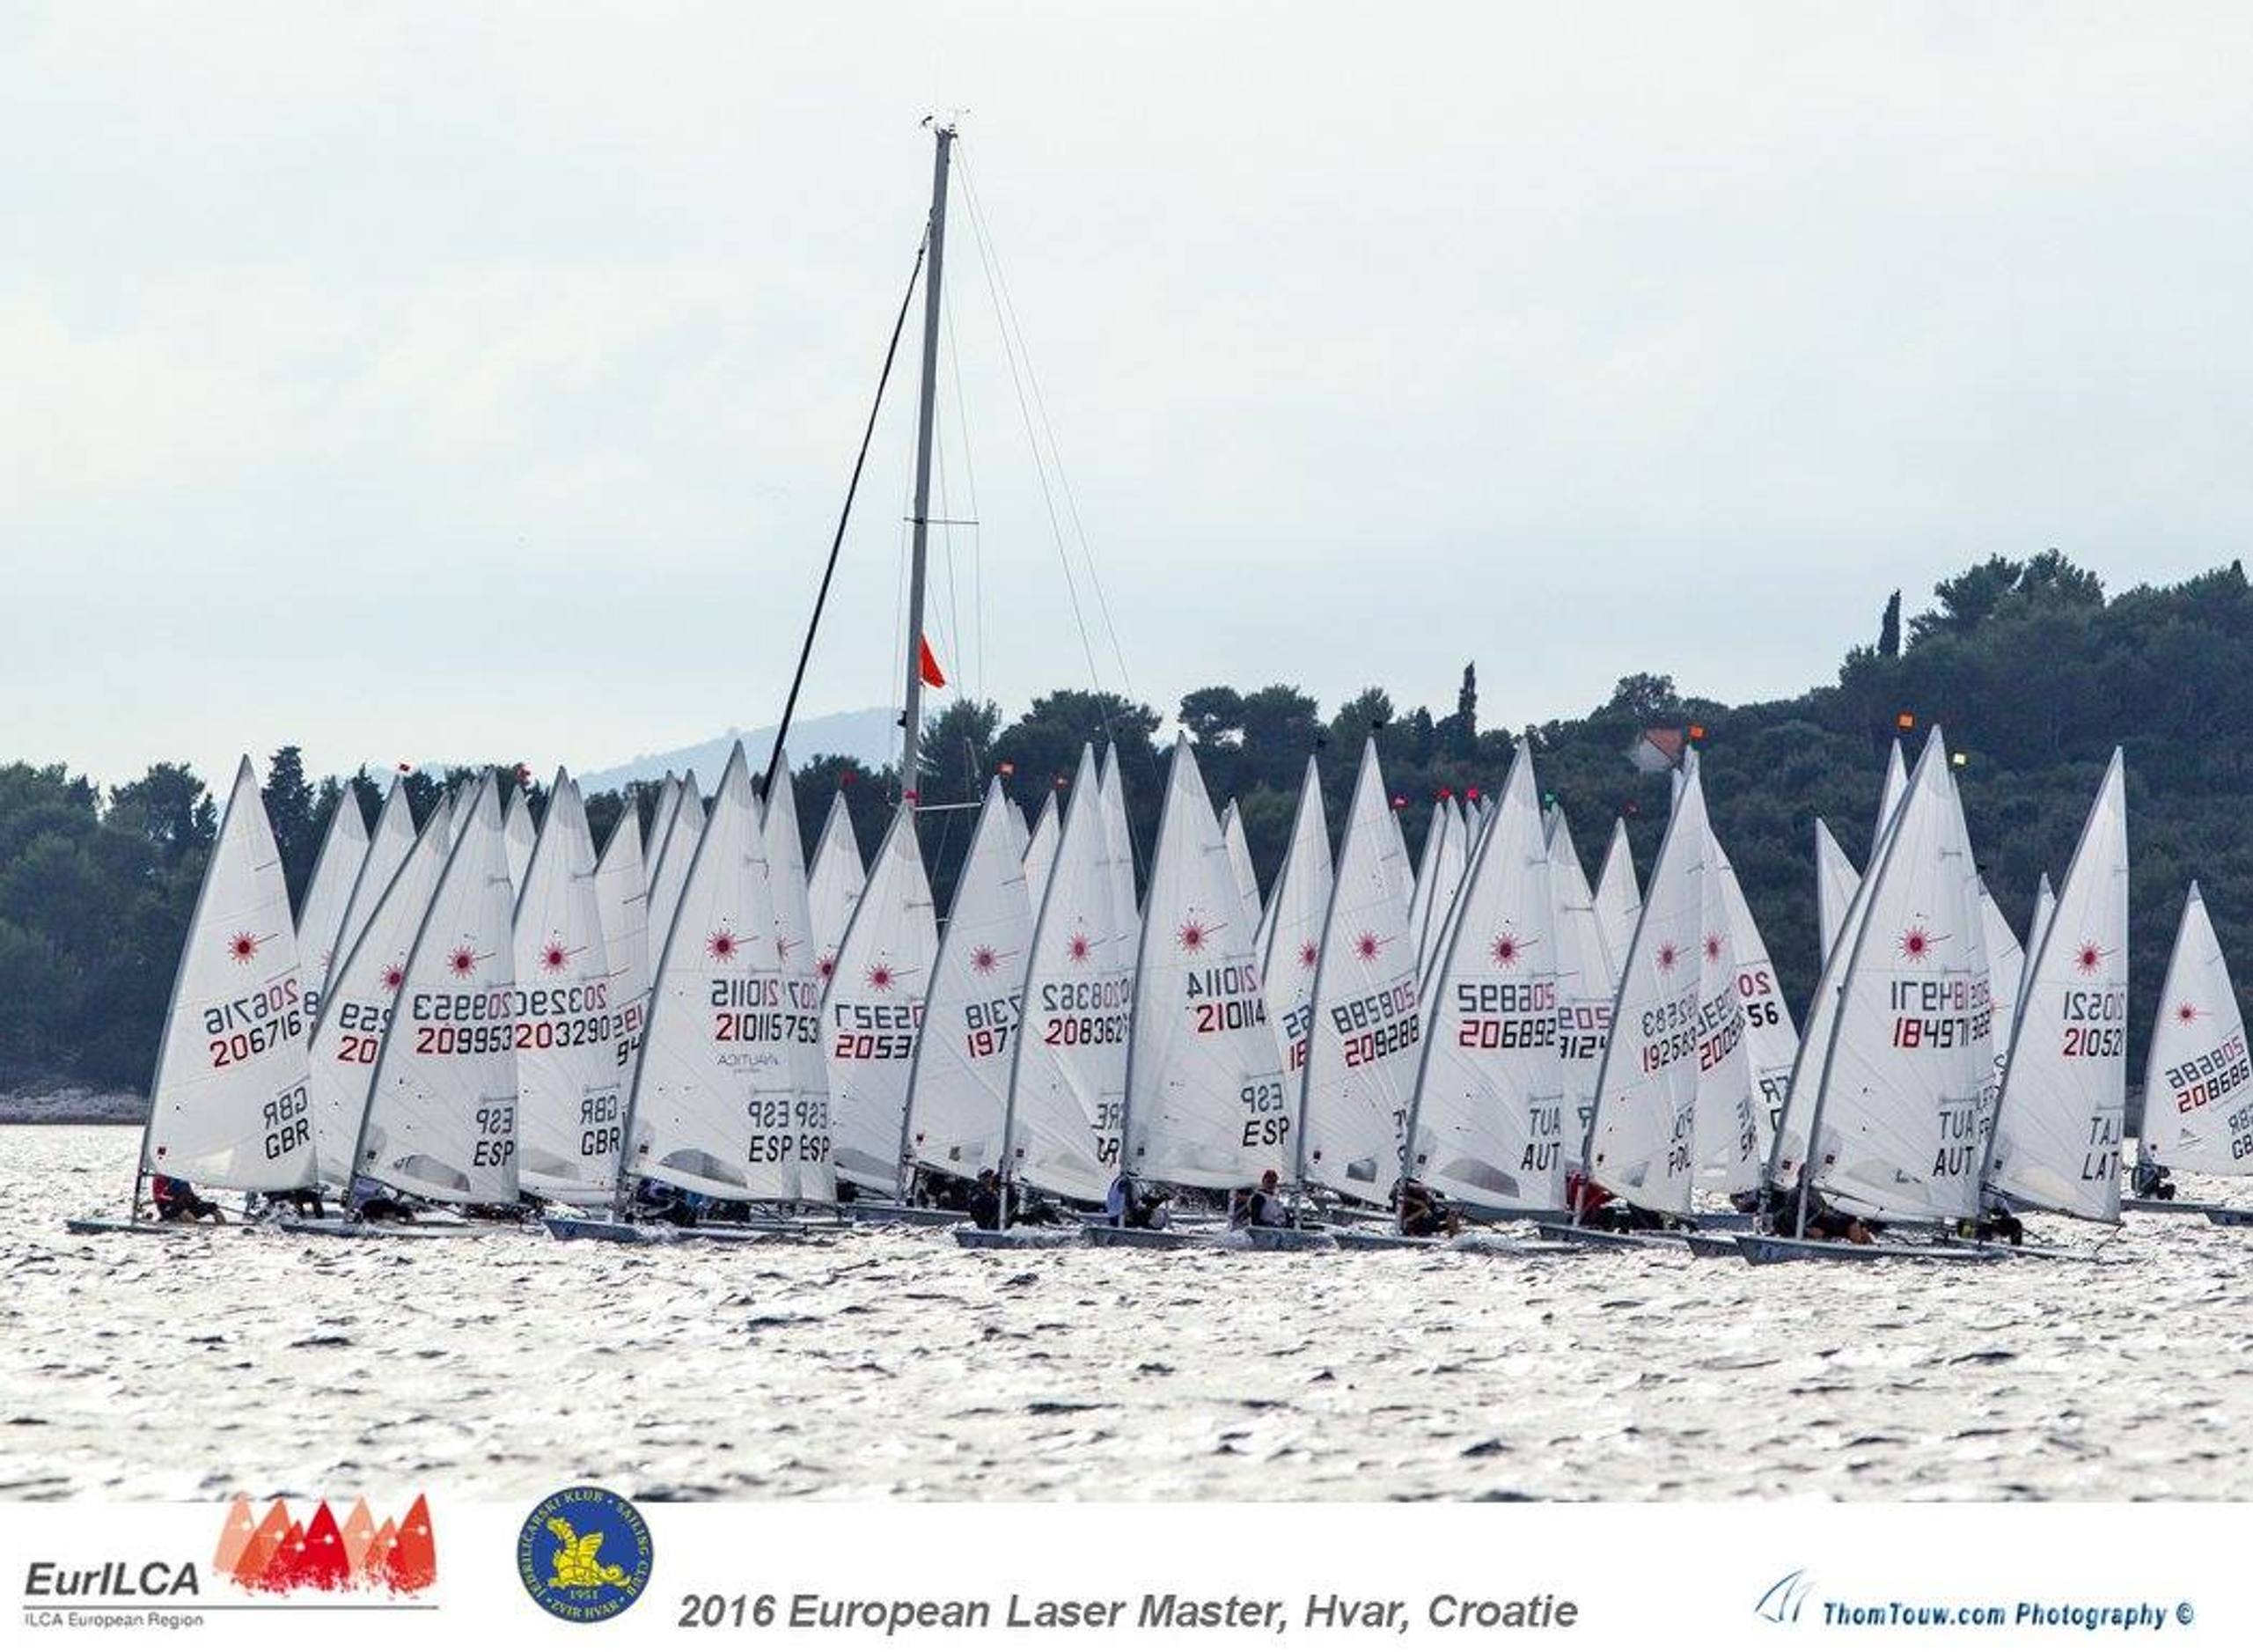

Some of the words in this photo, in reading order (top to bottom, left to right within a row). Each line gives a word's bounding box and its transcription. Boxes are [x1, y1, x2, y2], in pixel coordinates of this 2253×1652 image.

[1197, 997, 1266, 1032] 210114
[209, 1010, 301, 1068] 206716
[416, 1025, 512, 1054] 209953
[515, 1016, 609, 1048] 203290
[1045, 1017, 1122, 1045] 208362
[1459, 1017, 1556, 1049] 206892
[266, 1117, 311, 1160] GBR
[582, 1126, 620, 1155] GBR
[1242, 1115, 1290, 1147] ESP
[473, 1140, 515, 1167] ESP
[748, 1134, 793, 1163] ESP
[798, 1133, 831, 1163] ESP
[1521, 1141, 1561, 1171] AUT
[1932, 1145, 1974, 1177] AUT
[2081, 1151, 2119, 1181] LAT
